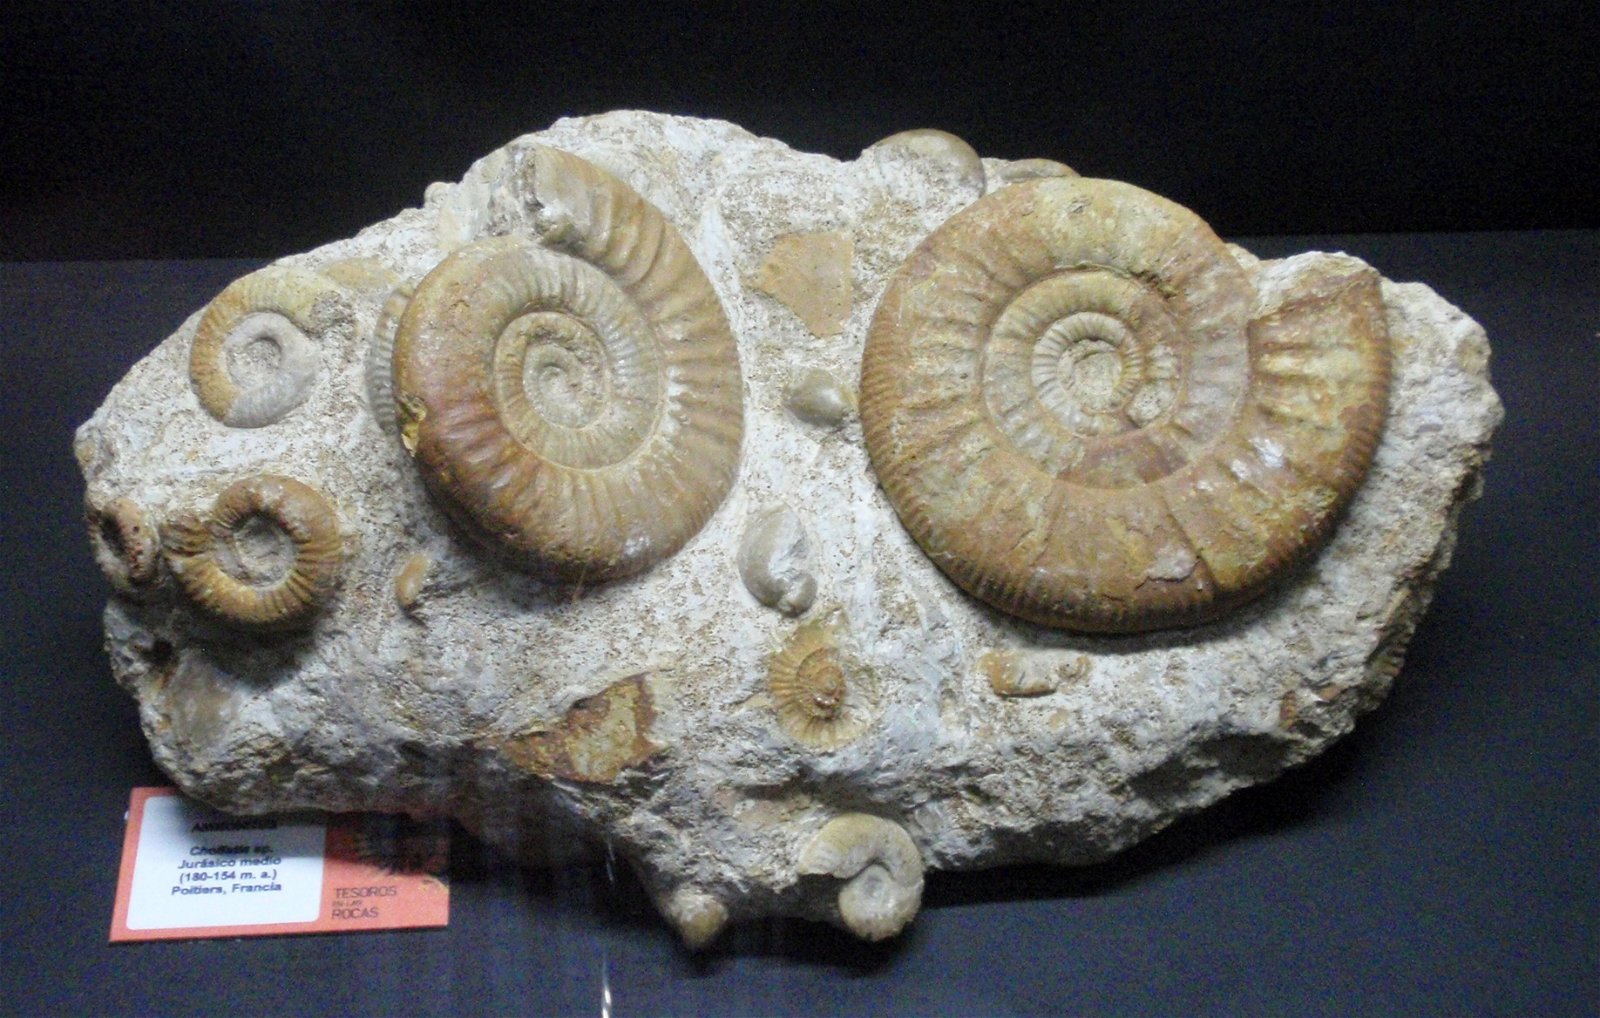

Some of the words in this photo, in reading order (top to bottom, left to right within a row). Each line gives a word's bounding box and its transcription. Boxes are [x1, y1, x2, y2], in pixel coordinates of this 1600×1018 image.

[240, 856, 282, 867] medio
[179, 870, 236, 883] (180-154
[240, 871, 256, 880] m.
[260, 869, 277, 881] a.)
[171, 885, 226, 896] Poitiers,
[232, 882, 282, 893] Francia
[336, 886, 397, 898] TESOROS
[331, 907, 379, 919] ROCAS
